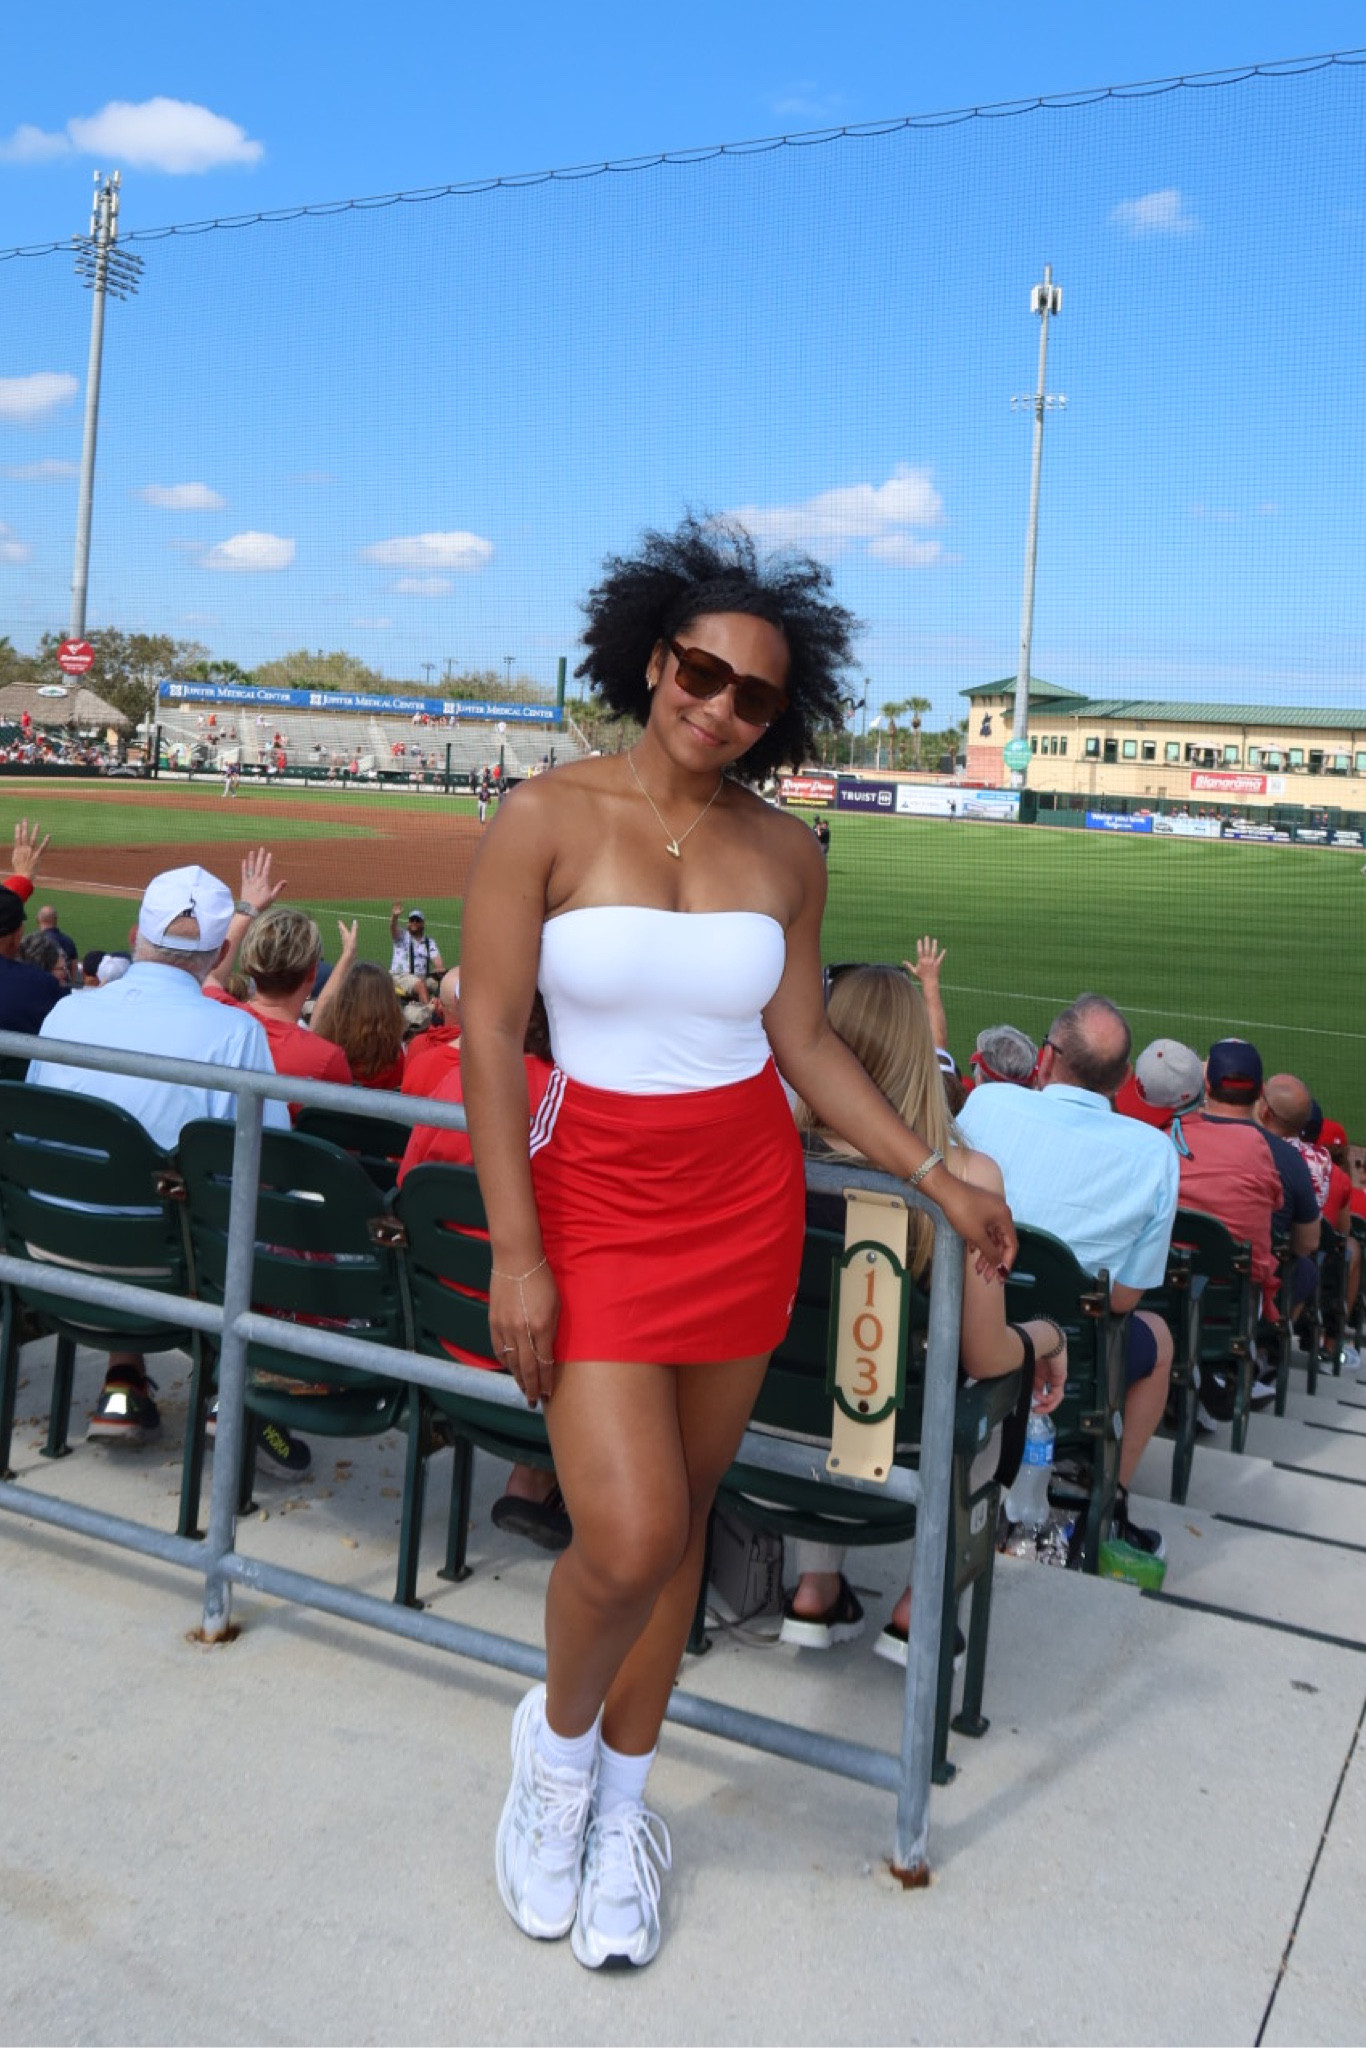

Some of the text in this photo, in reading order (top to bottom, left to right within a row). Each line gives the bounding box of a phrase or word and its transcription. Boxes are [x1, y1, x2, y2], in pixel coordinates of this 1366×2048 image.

[217, 687, 254, 699] MEDICAL
[257, 690, 290, 701] CENTER
[355, 696, 392, 708] MEDICAL
[393, 698, 425, 710] CENTER
[486, 704, 521, 716] MEDICAL
[523, 707, 554, 718] CENTER
[841, 790, 877, 802] TRUIST
[852, 1268, 883, 1397] 103
